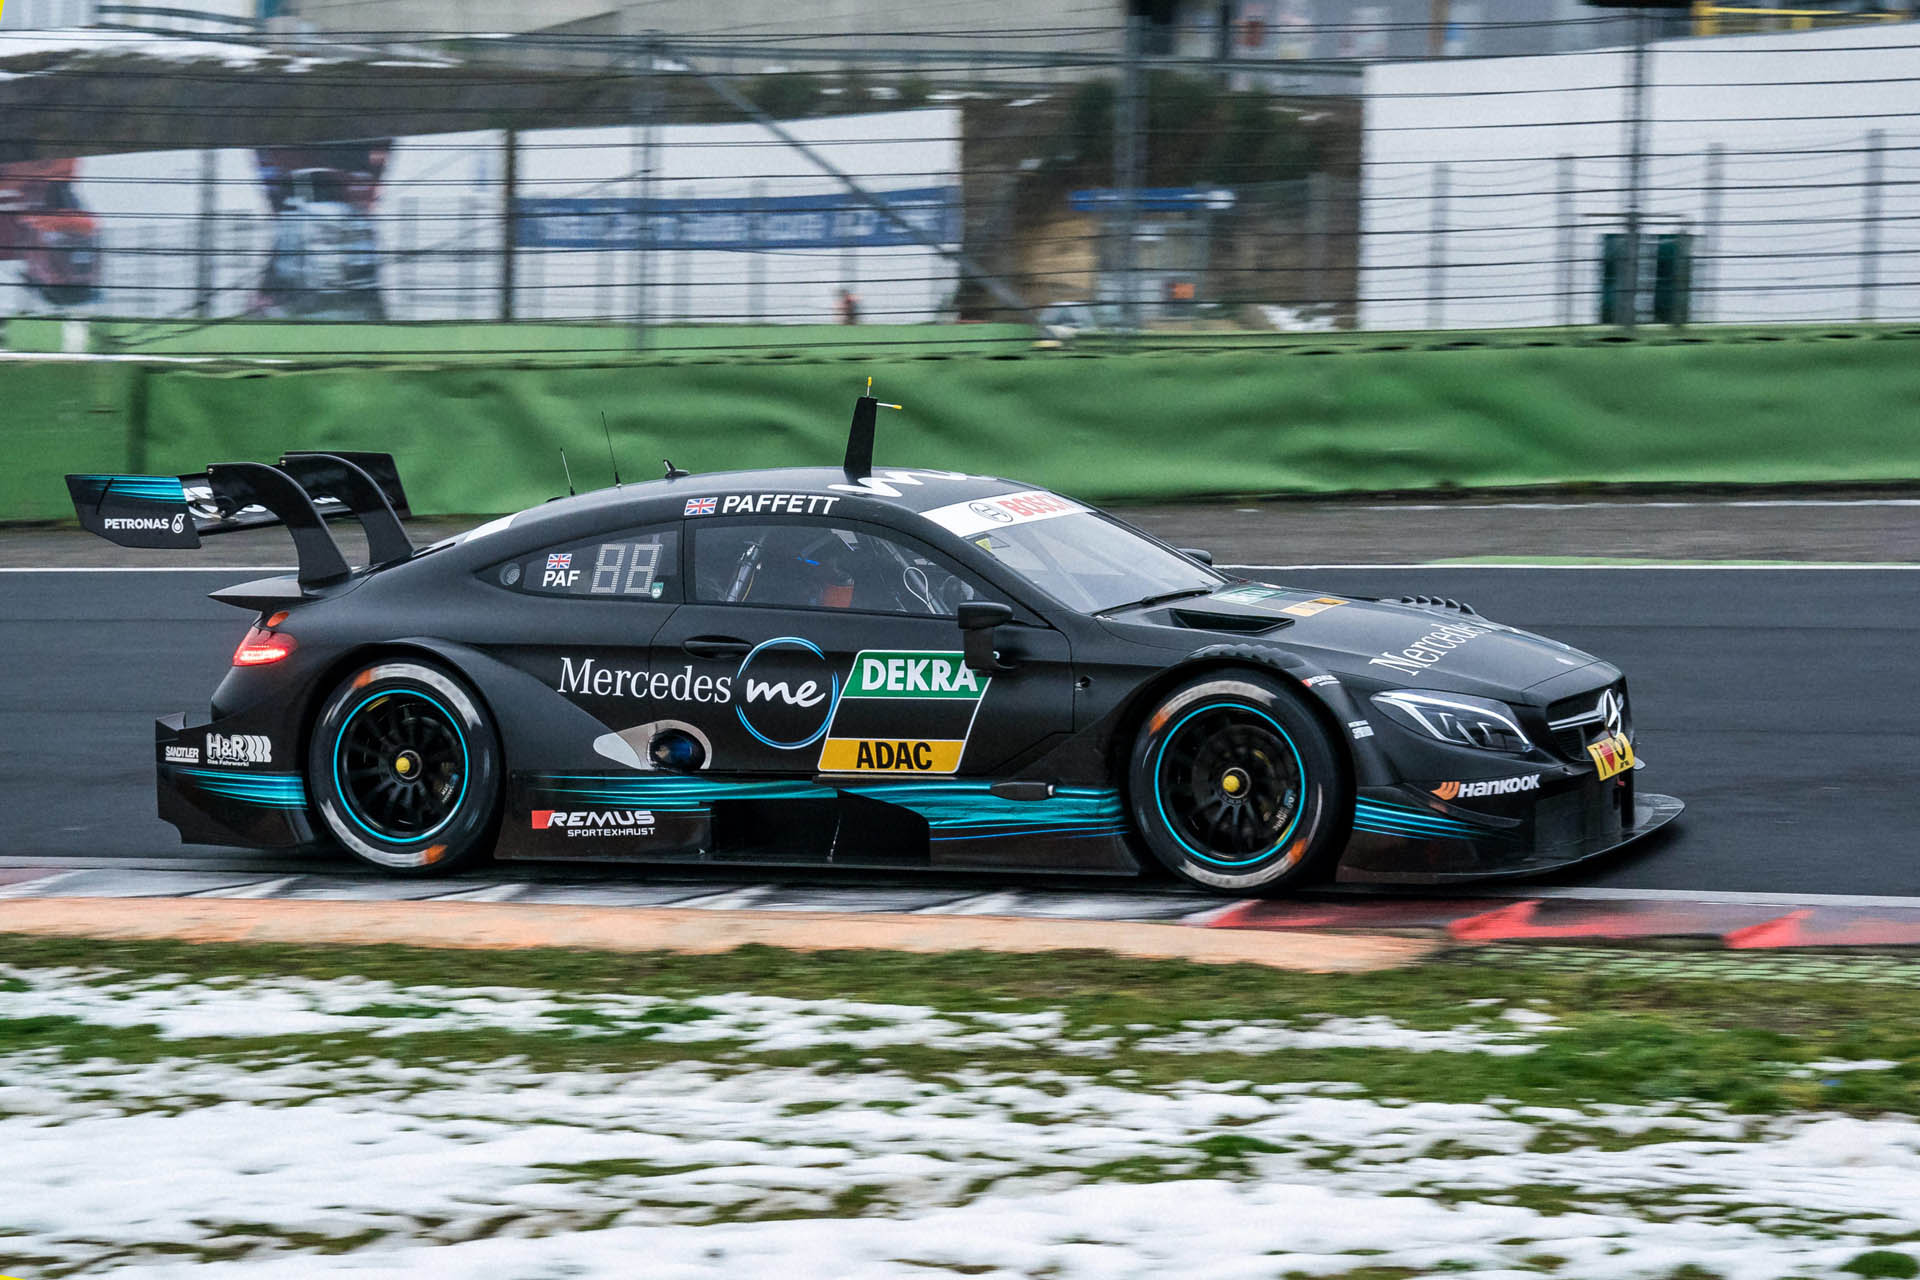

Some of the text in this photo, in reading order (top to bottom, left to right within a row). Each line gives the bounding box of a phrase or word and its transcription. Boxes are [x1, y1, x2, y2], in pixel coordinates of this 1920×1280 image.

[721, 493, 840, 515] PAFFETT
[104, 517, 169, 530] PETRONAS
[542, 570, 581, 587] PAF
[557, 657, 826, 708] Mercedes me
[861, 658, 978, 692] DEKRA
[165, 745, 199, 759] SANDTLER
[206, 732, 249, 762] H&R
[856, 741, 933, 770] ADAC
[546, 810, 656, 827] REMUS
[567, 827, 656, 837] SPORTEXHAUST
